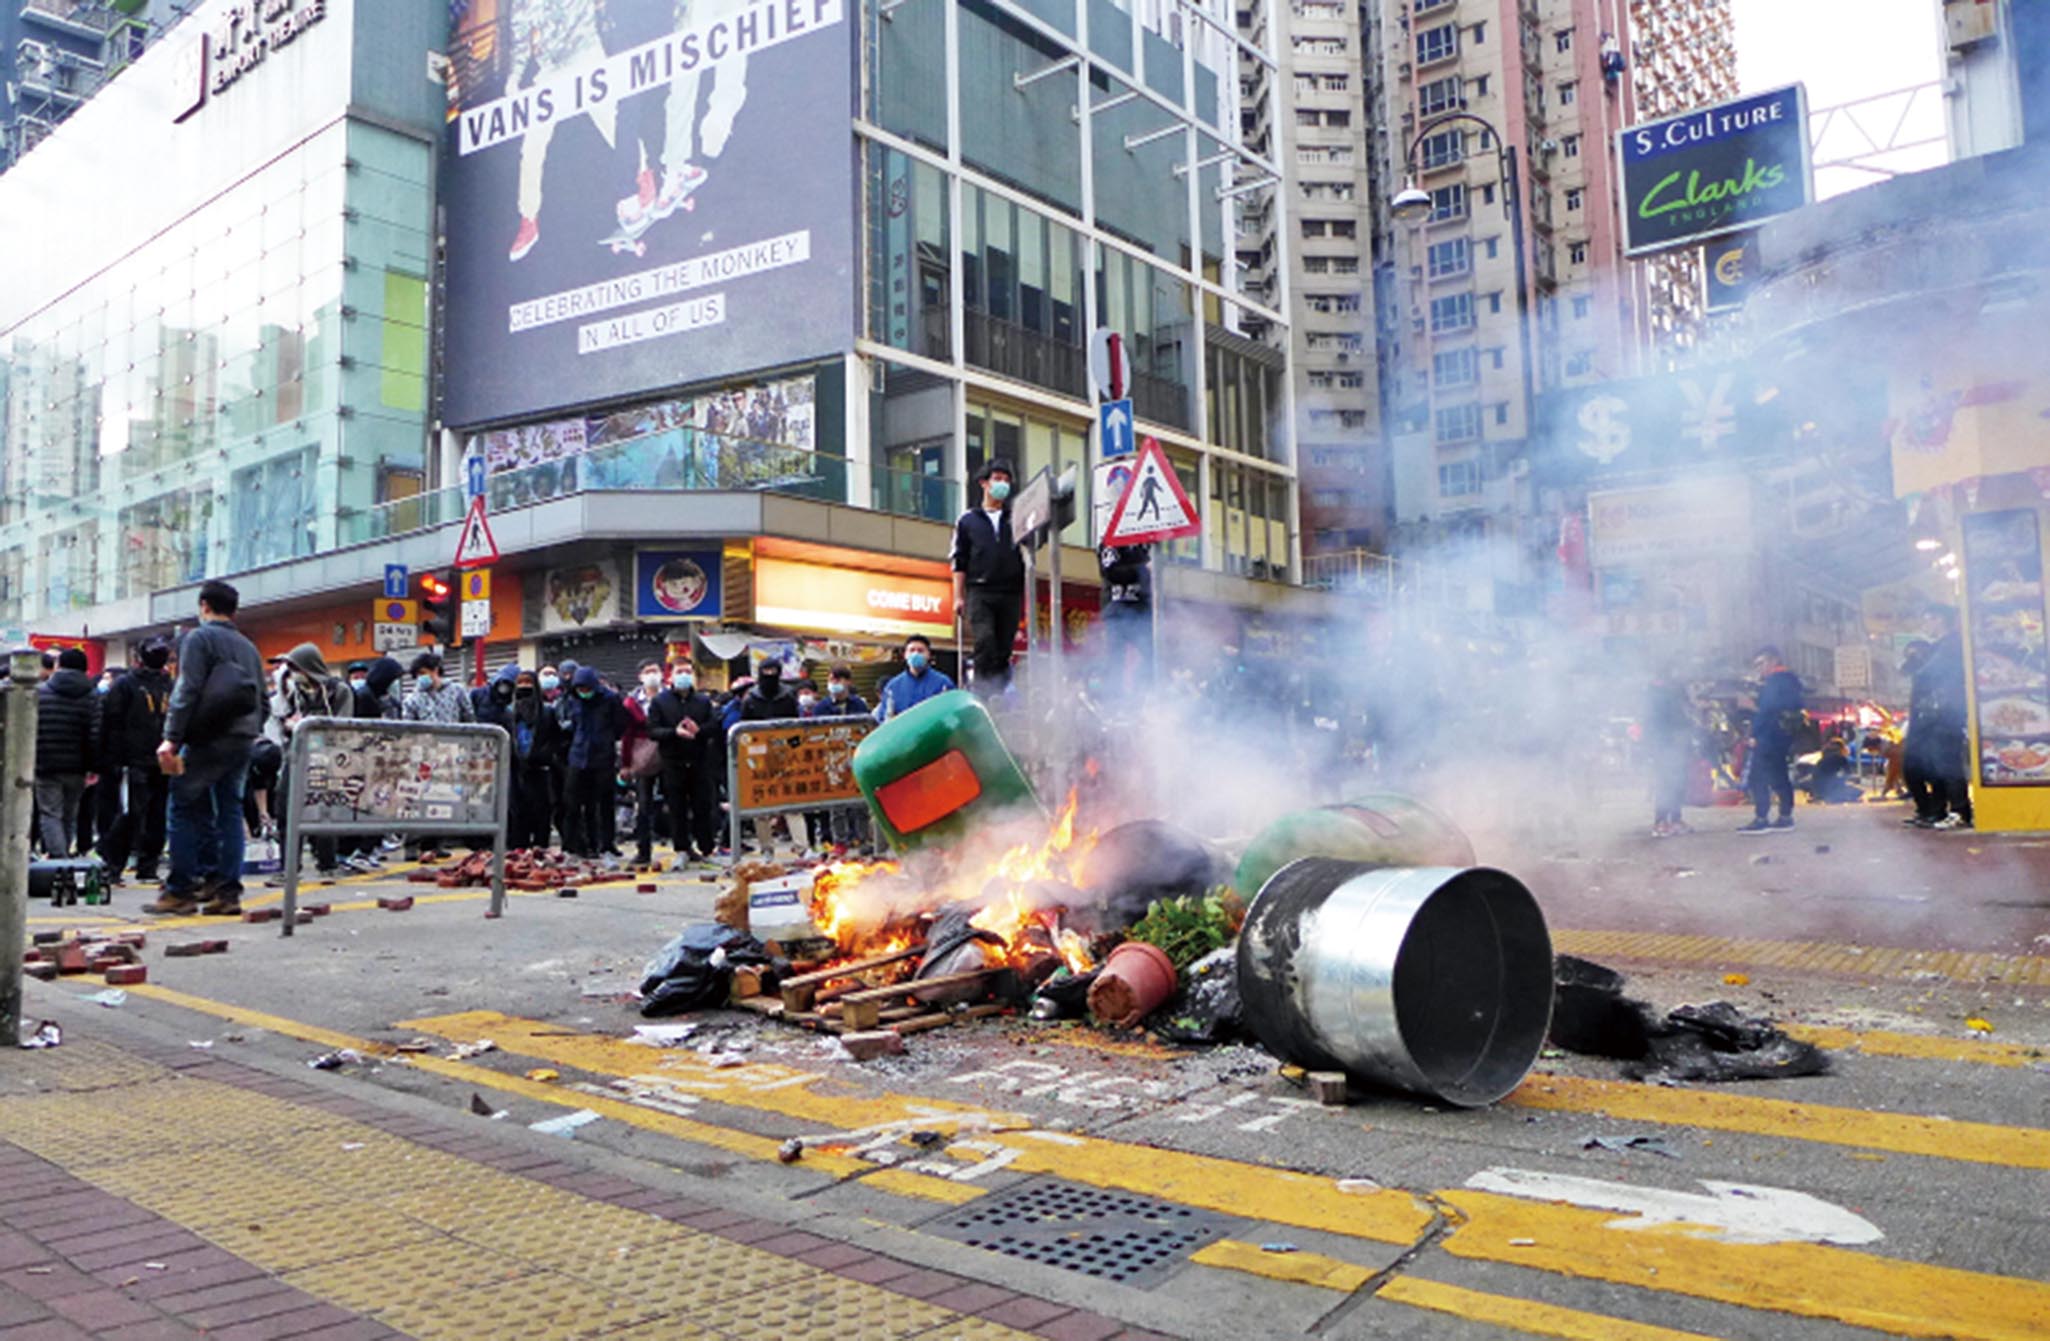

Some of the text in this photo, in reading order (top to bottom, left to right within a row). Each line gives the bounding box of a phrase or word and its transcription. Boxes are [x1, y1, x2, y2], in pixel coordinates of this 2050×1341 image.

[467, 89, 555, 146] VANS
[575, 67, 609, 110] IS
[1638, 157, 1785, 219] Clarks
[1669, 197, 1762, 226] ENGLAND
[511, 238, 800, 329] CELEBRATING THE MONKEY
[608, 323, 644, 344] ALL
[652, 306, 682, 333] OF
[690, 298, 720, 324] US
[866, 588, 943, 614] COME BUY
